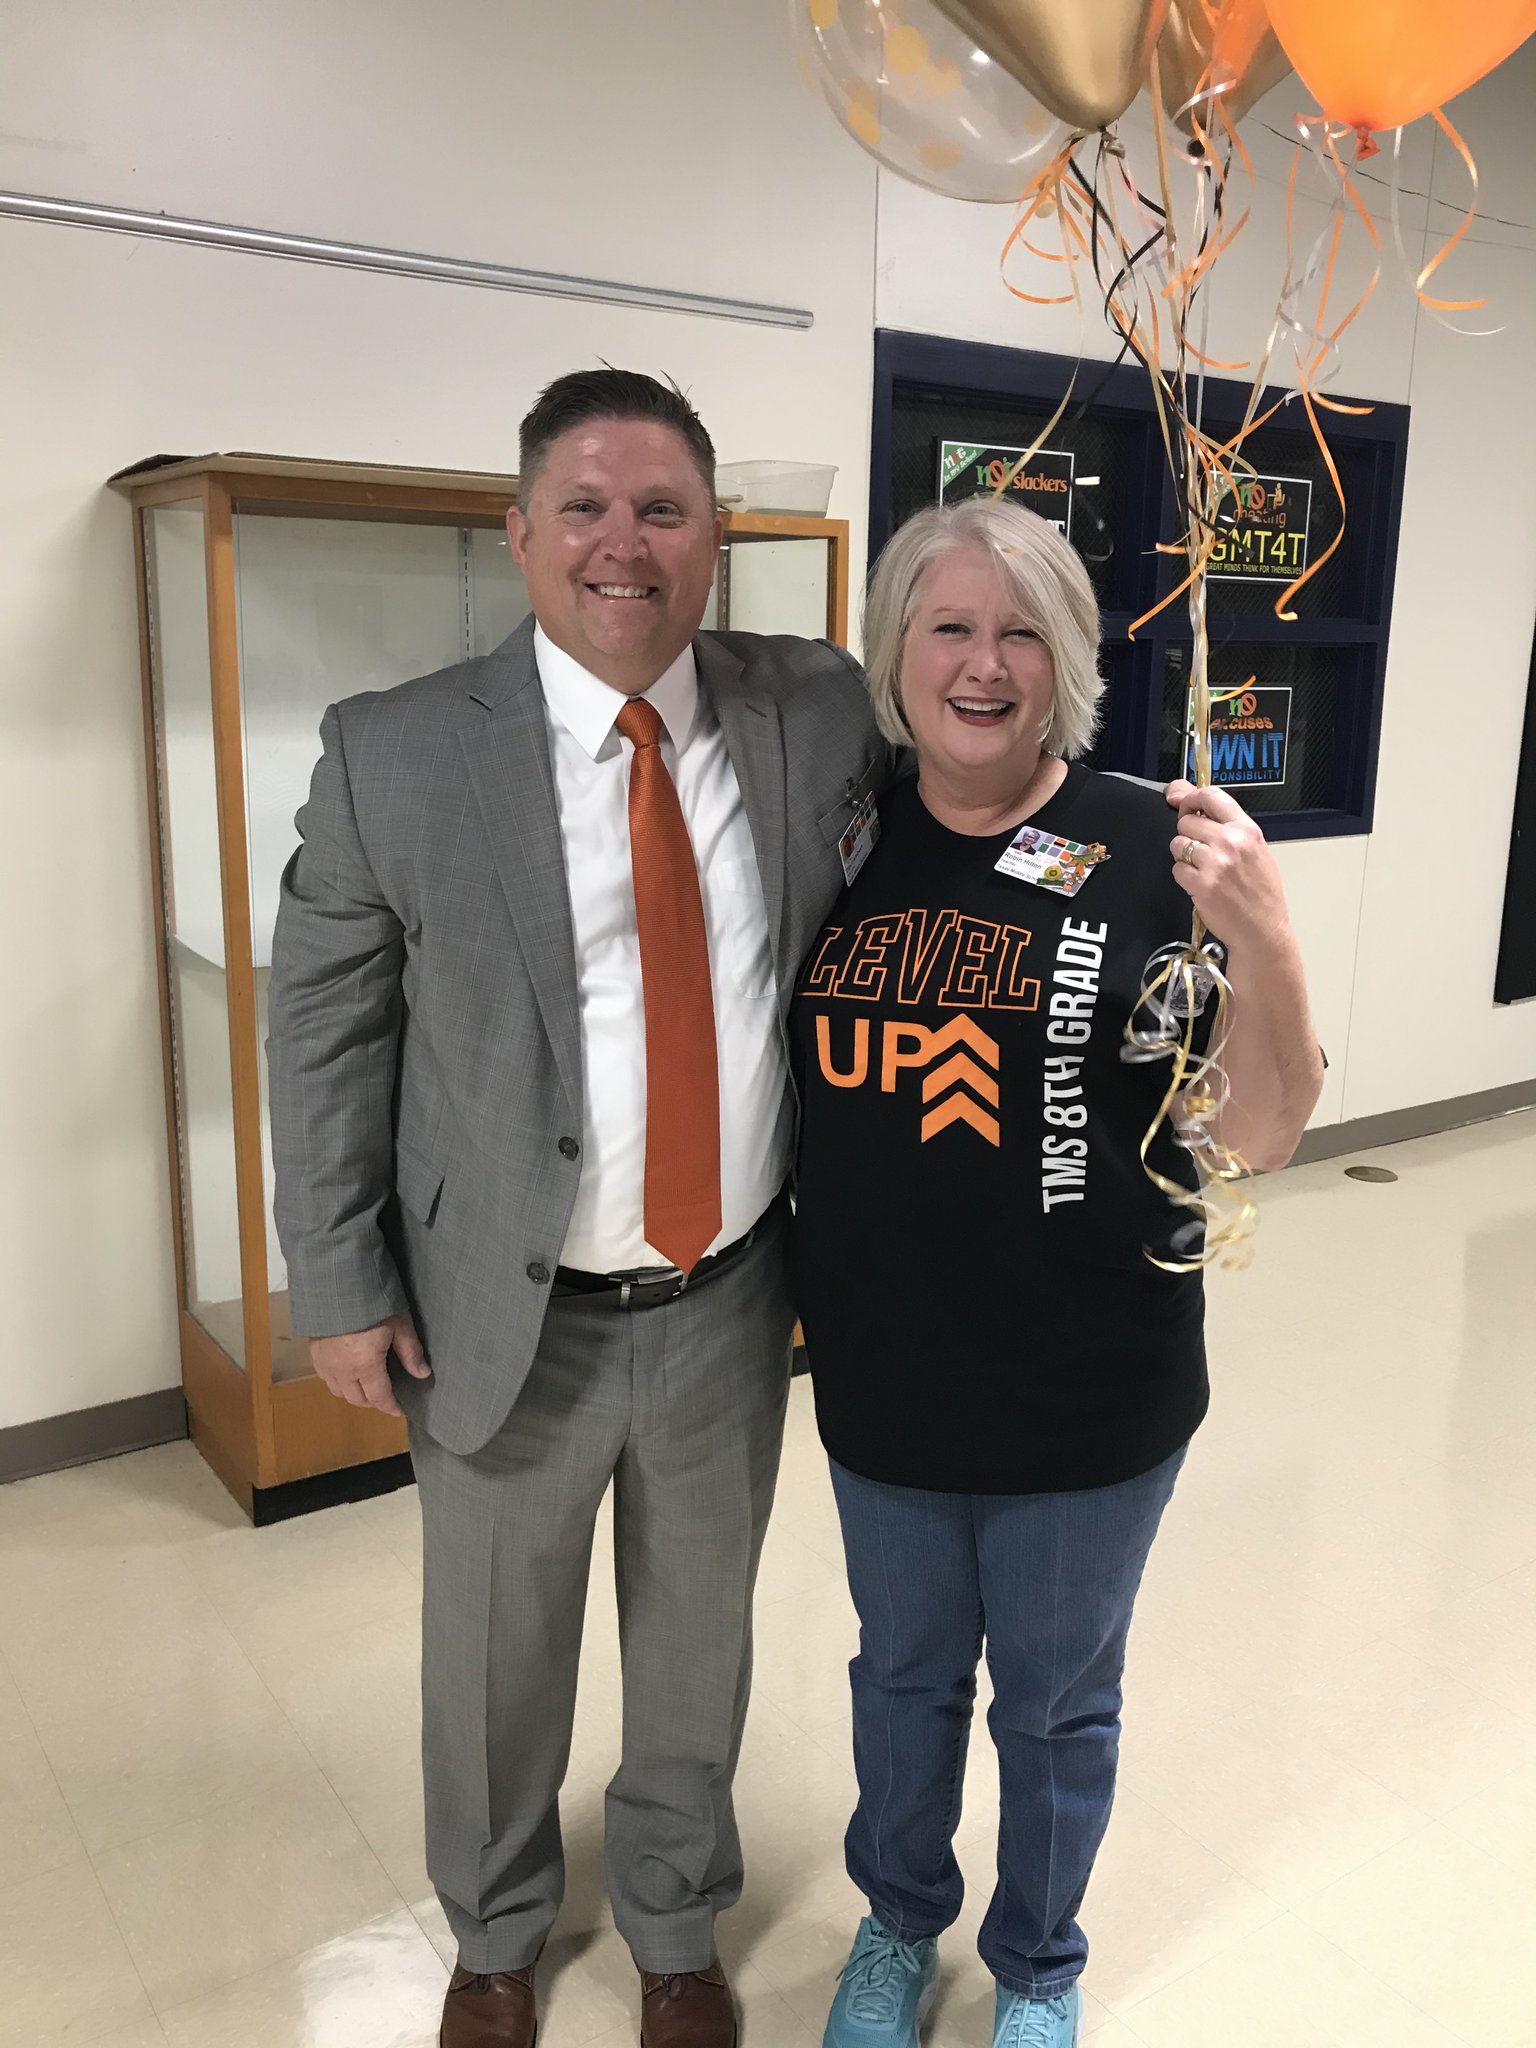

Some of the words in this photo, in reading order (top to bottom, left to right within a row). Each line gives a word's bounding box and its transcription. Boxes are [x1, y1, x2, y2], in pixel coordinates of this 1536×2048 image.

[1013, 471, 1068, 493] slackers
[1209, 527, 1306, 565] GMT4T
[1206, 562, 1224, 571] GREAT
[1223, 563, 1241, 572] MINDS
[1242, 564, 1258, 573] THINK
[1259, 564, 1271, 574] FOR
[1271, 565, 1303, 575] THEMSELVES
[1261, 732, 1284, 769] IT
[1189, 769, 1281, 783] RPONSIBILITY
[1004, 851, 1023, 863] Robin
[1023, 858, 1042, 870] Hilton
[797, 908, 1041, 1012] LEVEL
[1046, 916, 1108, 1045] GRADE
[815, 1014, 934, 1093] UP
[1043, 1055, 1088, 1129] 8TH
[1041, 1135, 1089, 1214] TMS
